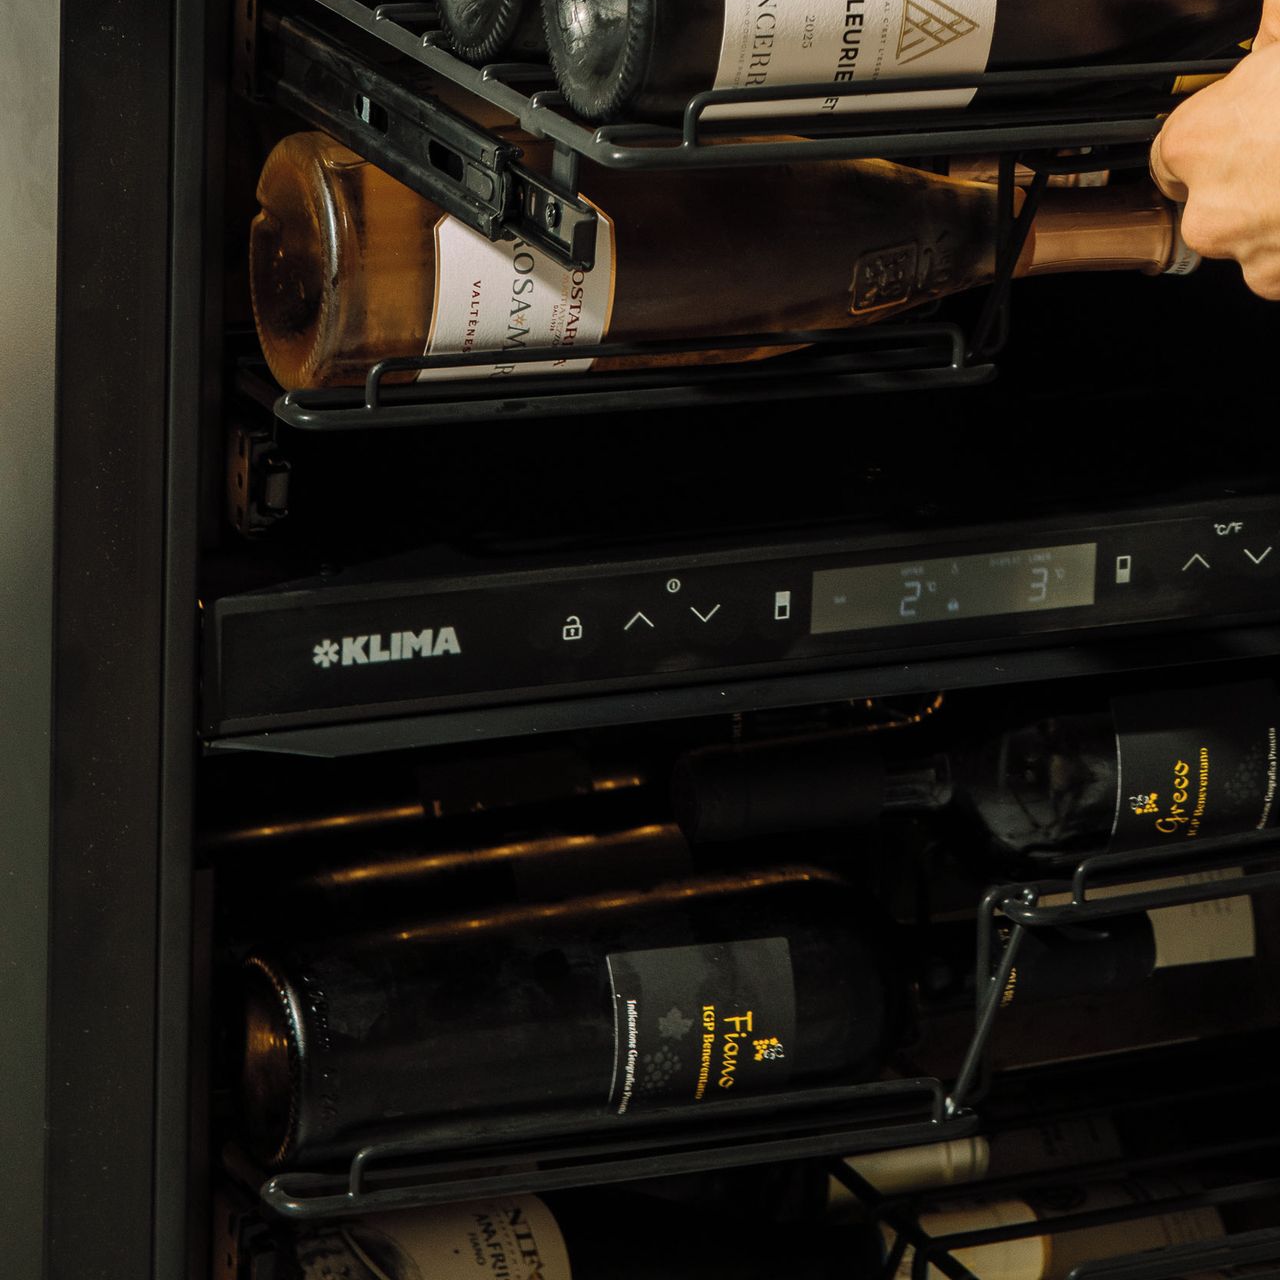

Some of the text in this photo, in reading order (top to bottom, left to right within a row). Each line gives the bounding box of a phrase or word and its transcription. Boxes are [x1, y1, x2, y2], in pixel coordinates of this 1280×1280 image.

[802, 15, 816, 49] 2025
[462, 280, 481, 353] VALTÈNES
[341, 626, 461, 666] KLIMA
[1155, 760, 1190, 833] Greco
[1193, 747, 1209, 816] Beneventano
[695, 1005, 715, 1100] IGP Beneventano
[718, 1010, 753, 1089] Fiano
